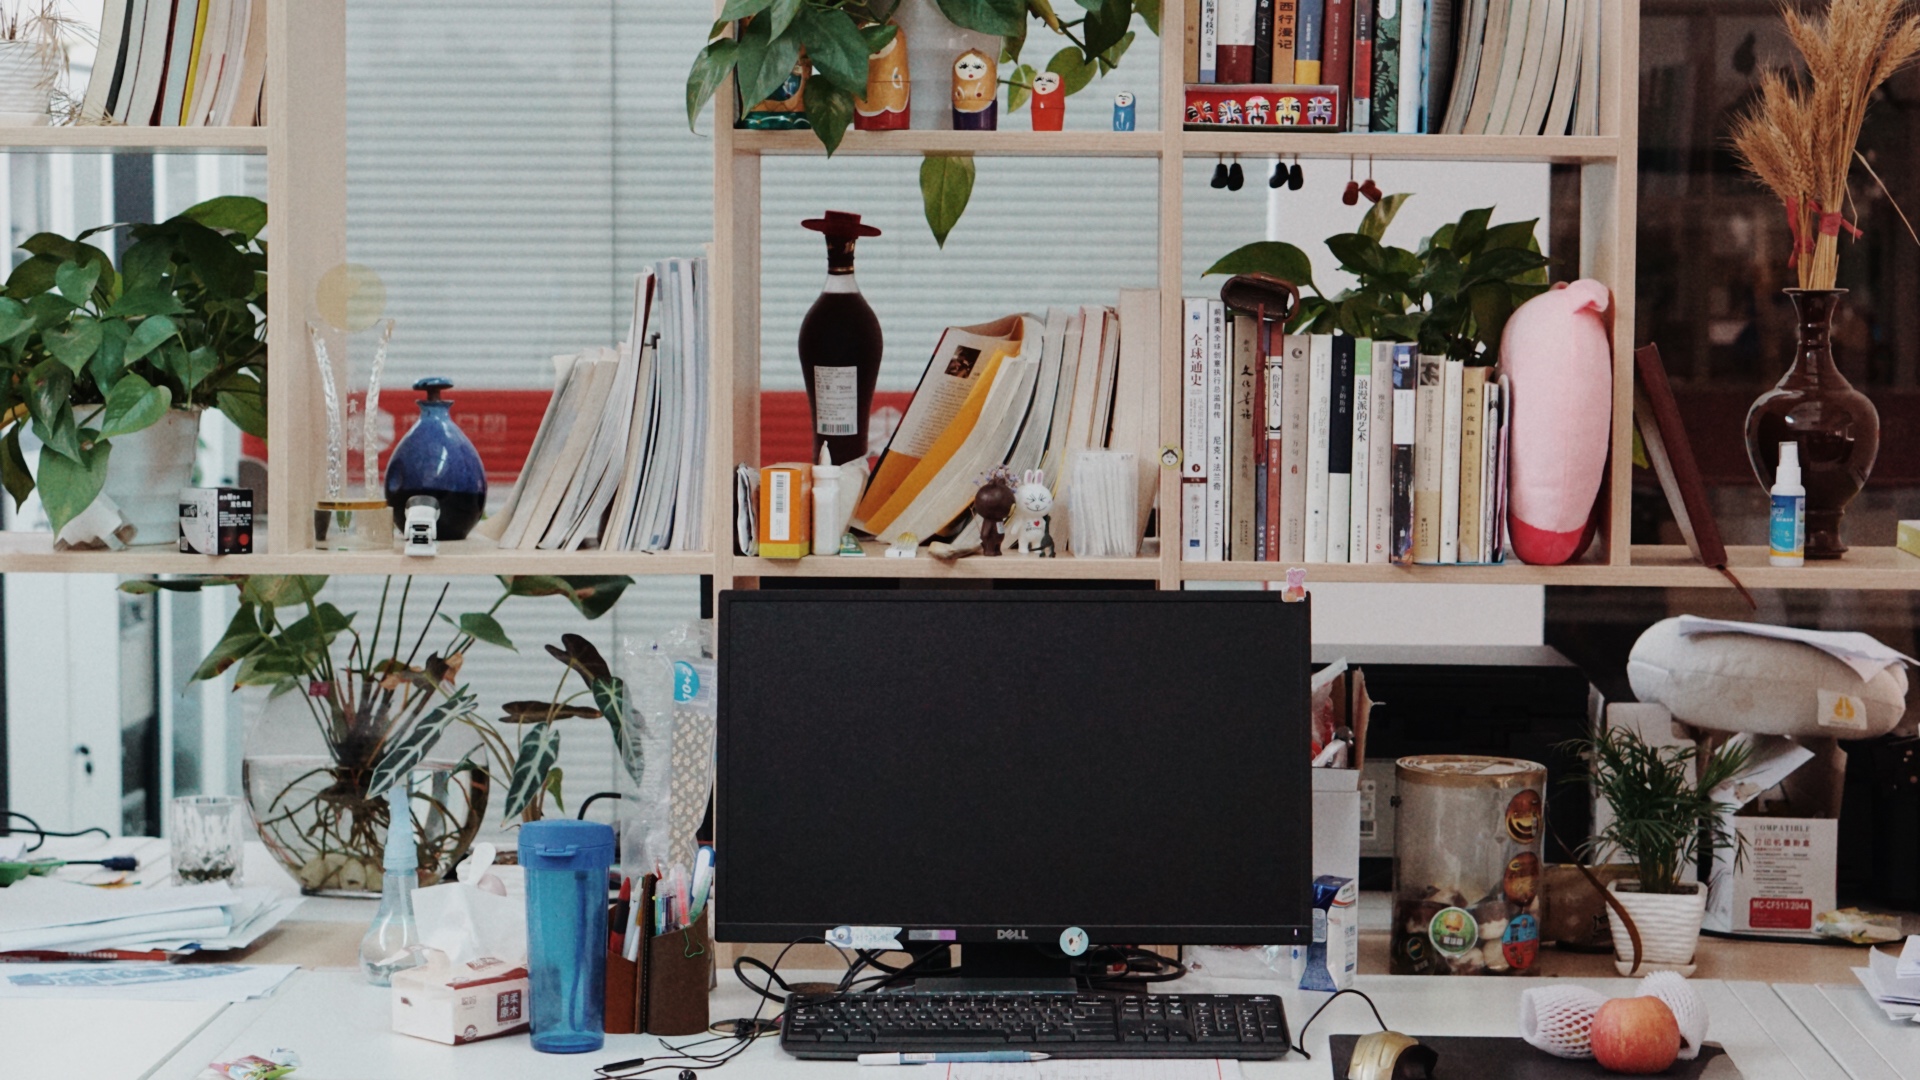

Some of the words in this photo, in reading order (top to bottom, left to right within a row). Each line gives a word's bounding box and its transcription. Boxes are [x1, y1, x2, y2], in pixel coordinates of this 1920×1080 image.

[1278, 2, 1293, 49] 西行漫记
[1190, 333, 1203, 387] 全球通史
[1356, 379, 1368, 442] 浪漫派的艺术
[682, 667, 692, 699] 10+2
[997, 929, 1028, 940] DELL
